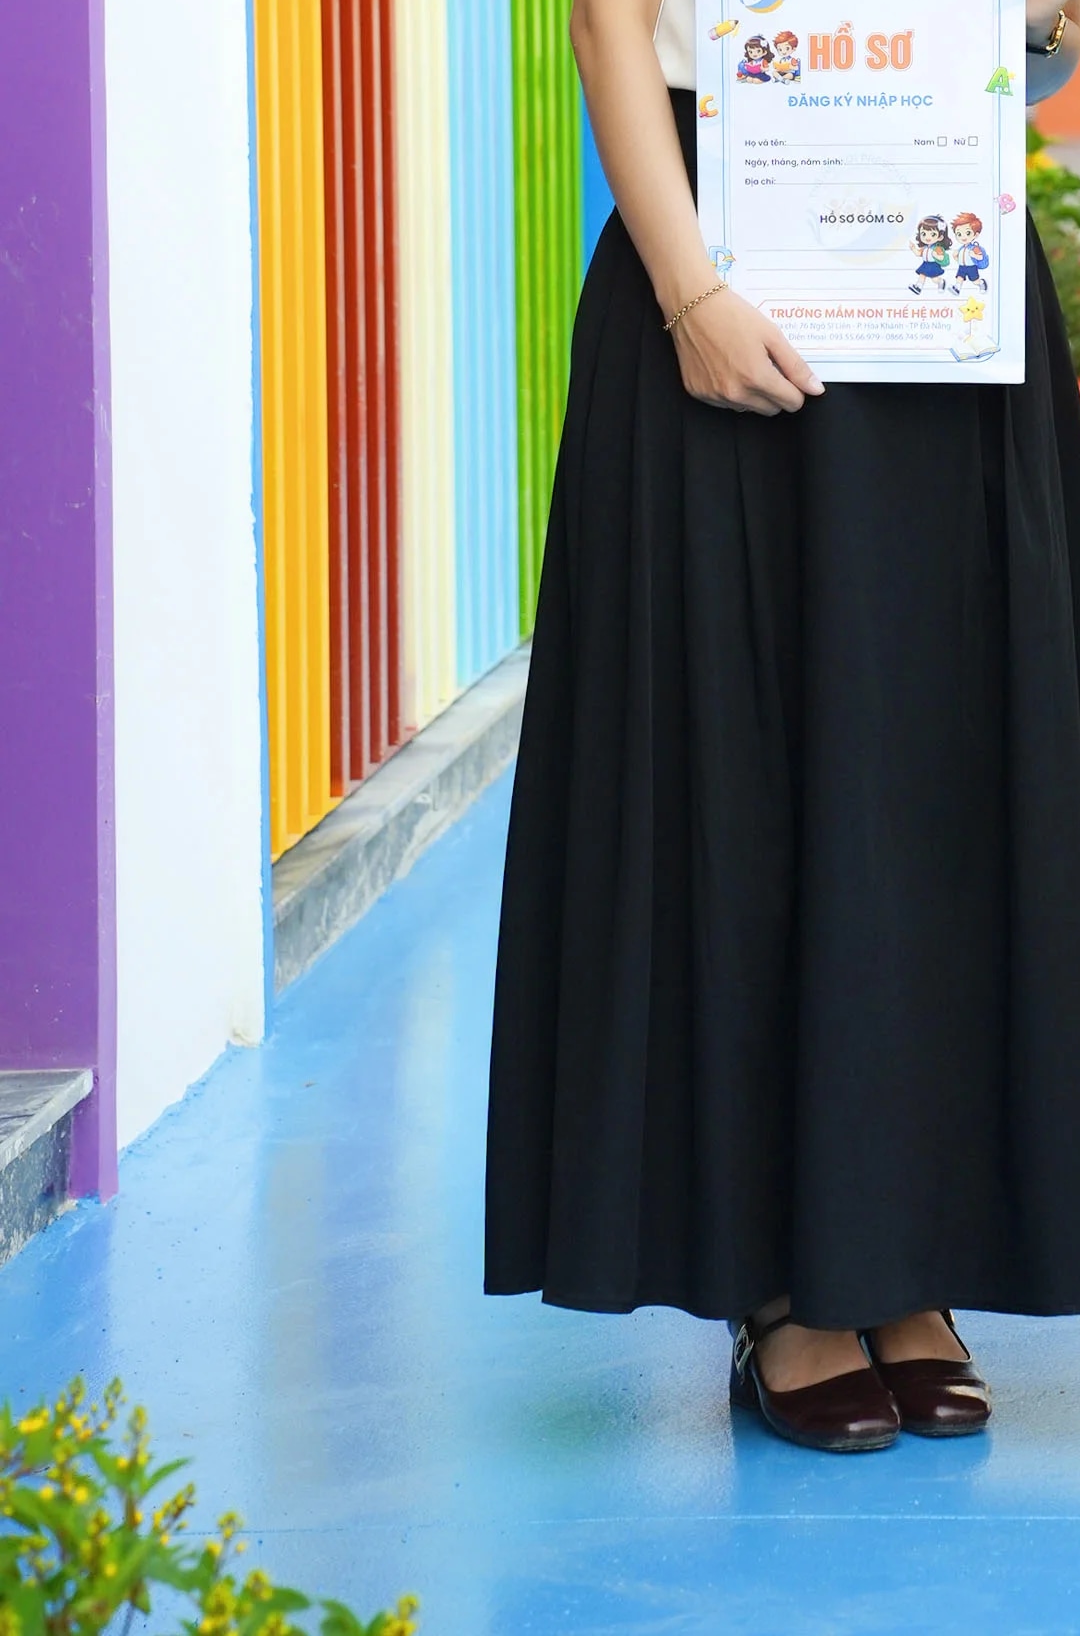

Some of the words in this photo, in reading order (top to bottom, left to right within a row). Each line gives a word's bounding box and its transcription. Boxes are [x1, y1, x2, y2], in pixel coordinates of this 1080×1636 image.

[809, 21, 855, 71] HỒ
[866, 30, 914, 71] SƠ
[788, 93, 830, 107] ĐĂNG
[834, 92, 853, 107] KÝ
[857, 92, 897, 109] NHẬP
[901, 95, 933, 109] HỌC
[745, 139, 756, 148] Họ
[954, 137, 966, 145] Nữ
[771, 157, 799, 168] tháng,
[745, 178, 759, 187] Địa
[820, 210, 837, 224] HỒ
[839, 213, 855, 224] SƠ
[857, 209, 885, 224] GỒM
[887, 211, 904, 224] CÓ
[770, 305, 822, 318] TRƯỜNG
[825, 304, 855, 318] MẦM
[857, 308, 884, 318] NON
[886, 304, 909, 318] THẾ
[911, 305, 927, 322] HỆ
[929, 305, 953, 318] MỚI
